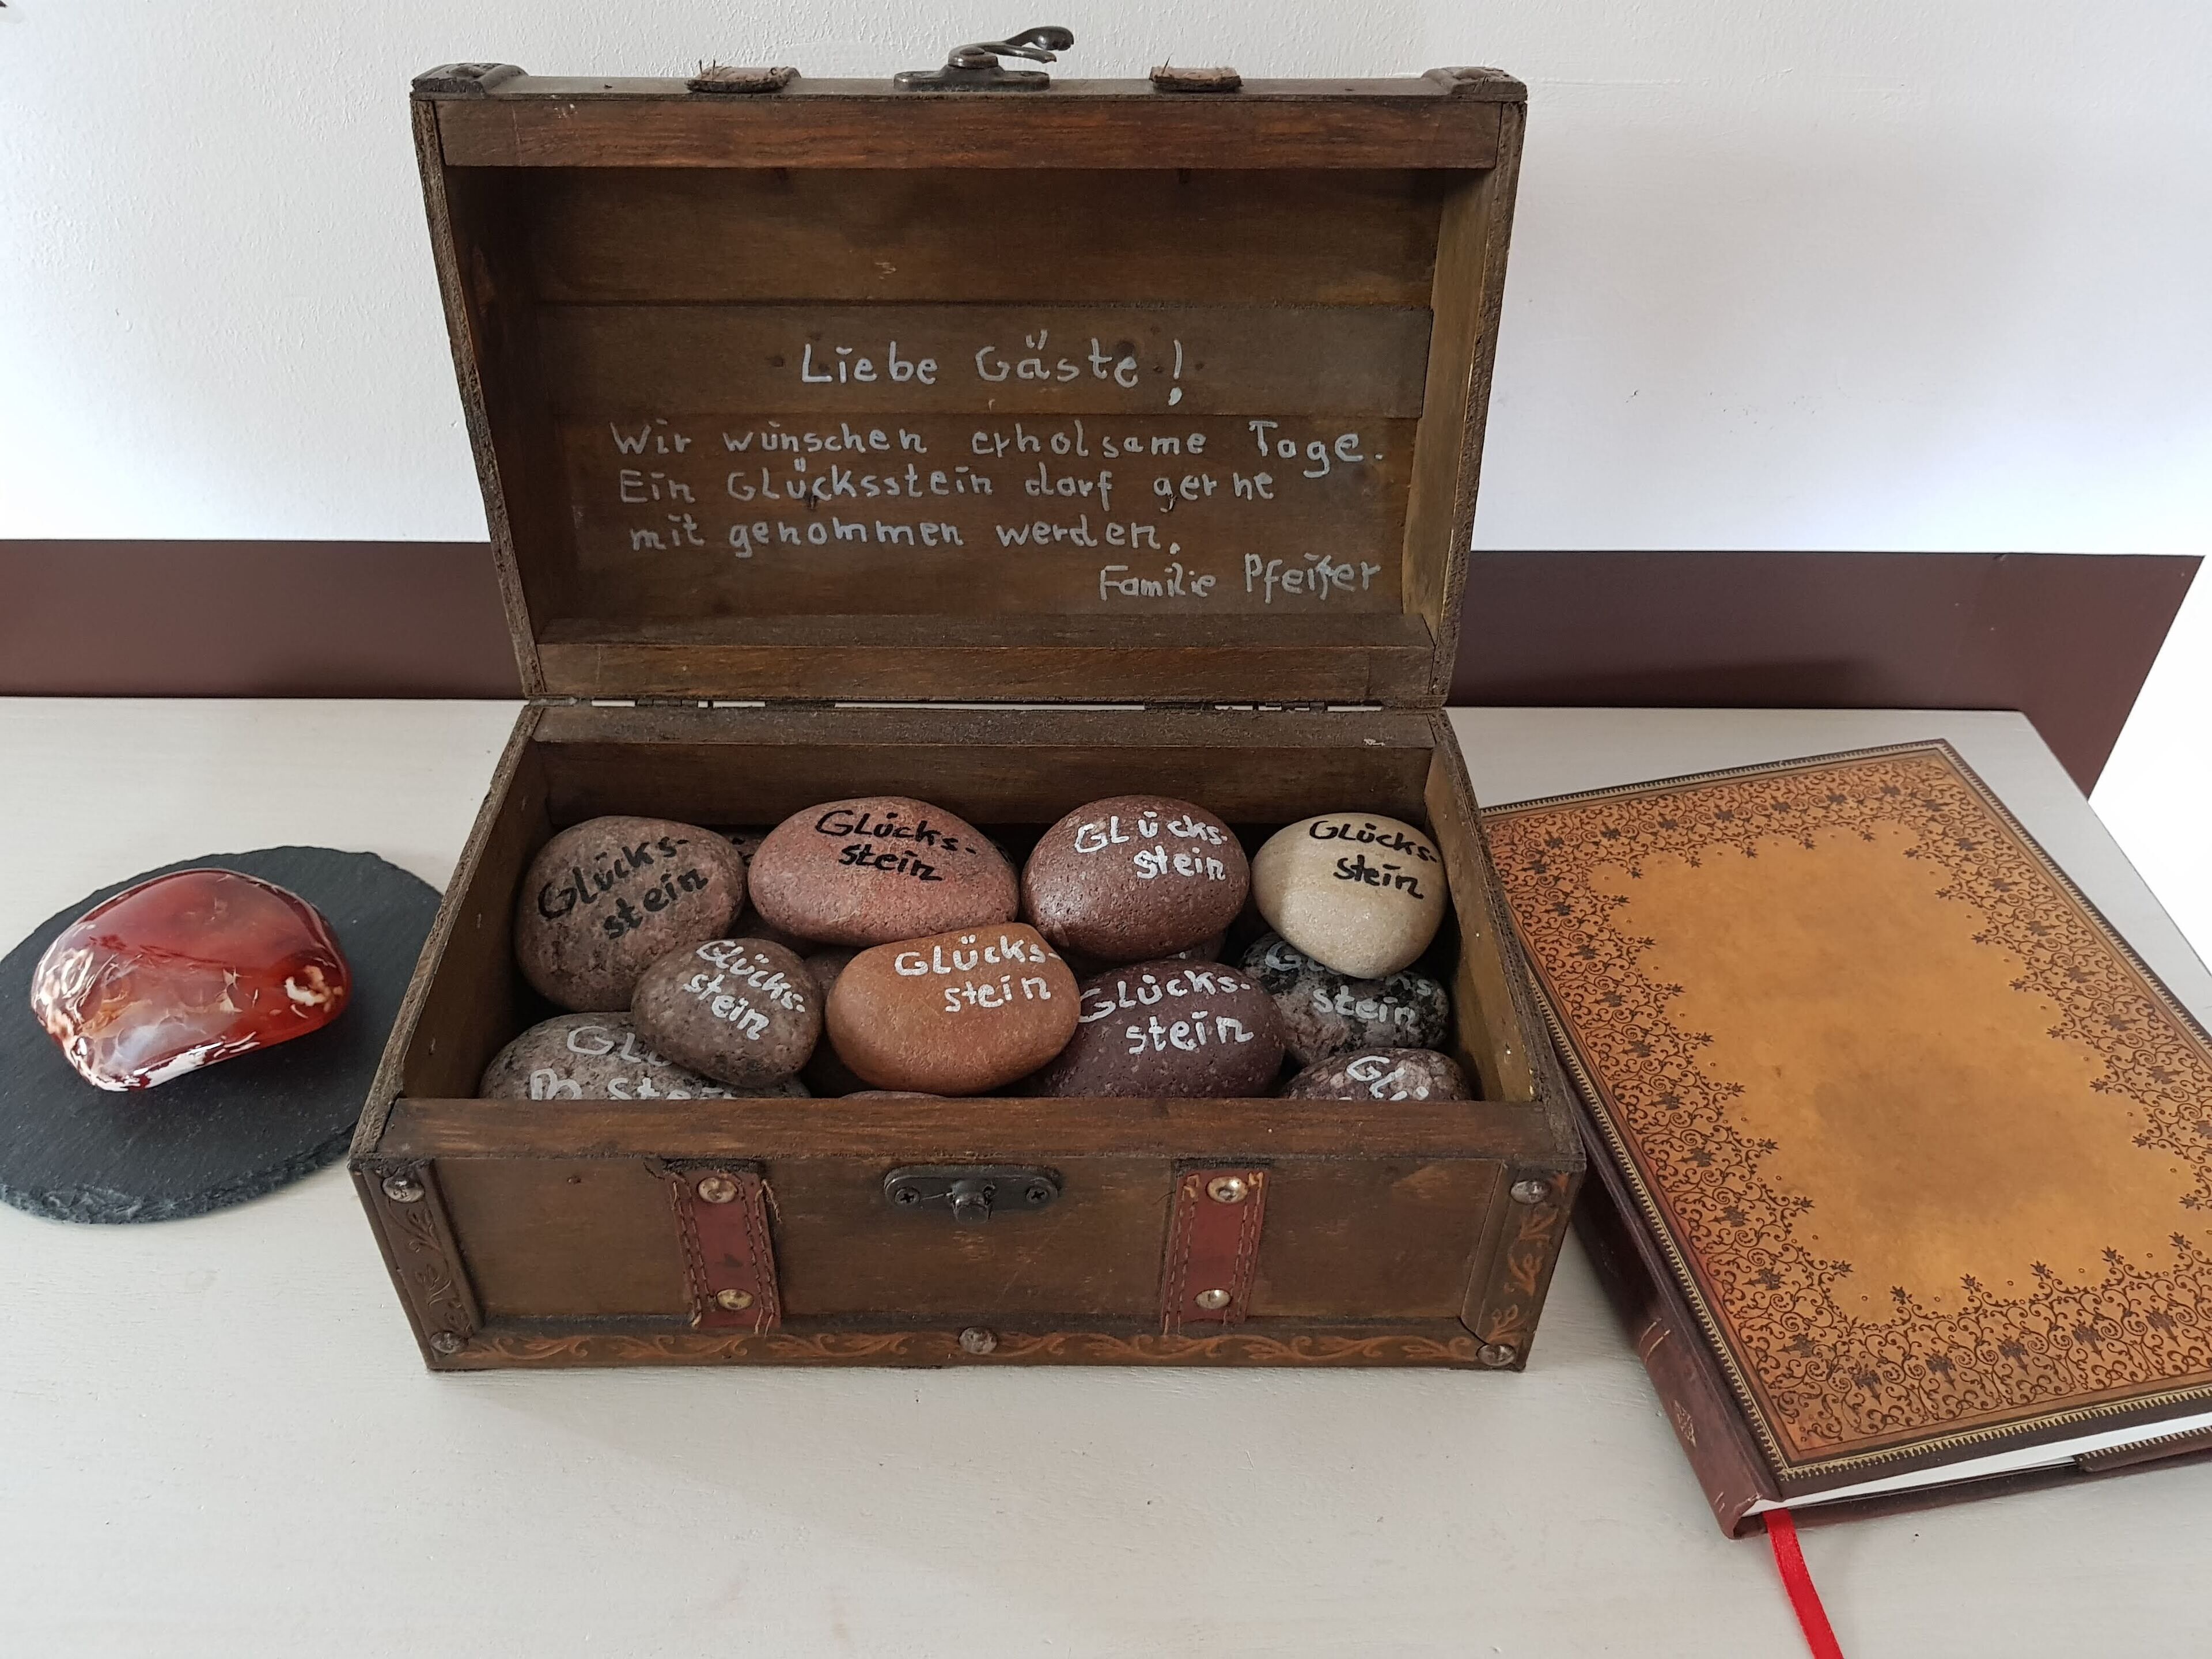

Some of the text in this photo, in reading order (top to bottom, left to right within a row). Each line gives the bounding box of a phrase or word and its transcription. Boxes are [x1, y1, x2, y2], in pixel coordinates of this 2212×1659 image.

[801, 340, 938, 385] Liebe
[610, 418, 1382, 478] Wir wünschen erholsame Tage.
[620, 469, 695, 503] Ein
[1025, 462, 1112, 511] darf
[630, 513, 1181, 558] mit genommen werden.
[1100, 562, 1217, 601] Familie
[838, 843, 943, 882] stein
[1133, 845, 1226, 881] stein
[1332, 854, 1425, 900] stein
[683, 972, 771, 1041] stein
[944, 974, 1052, 1013] stein
[1126, 1010, 1255, 1055] stein
